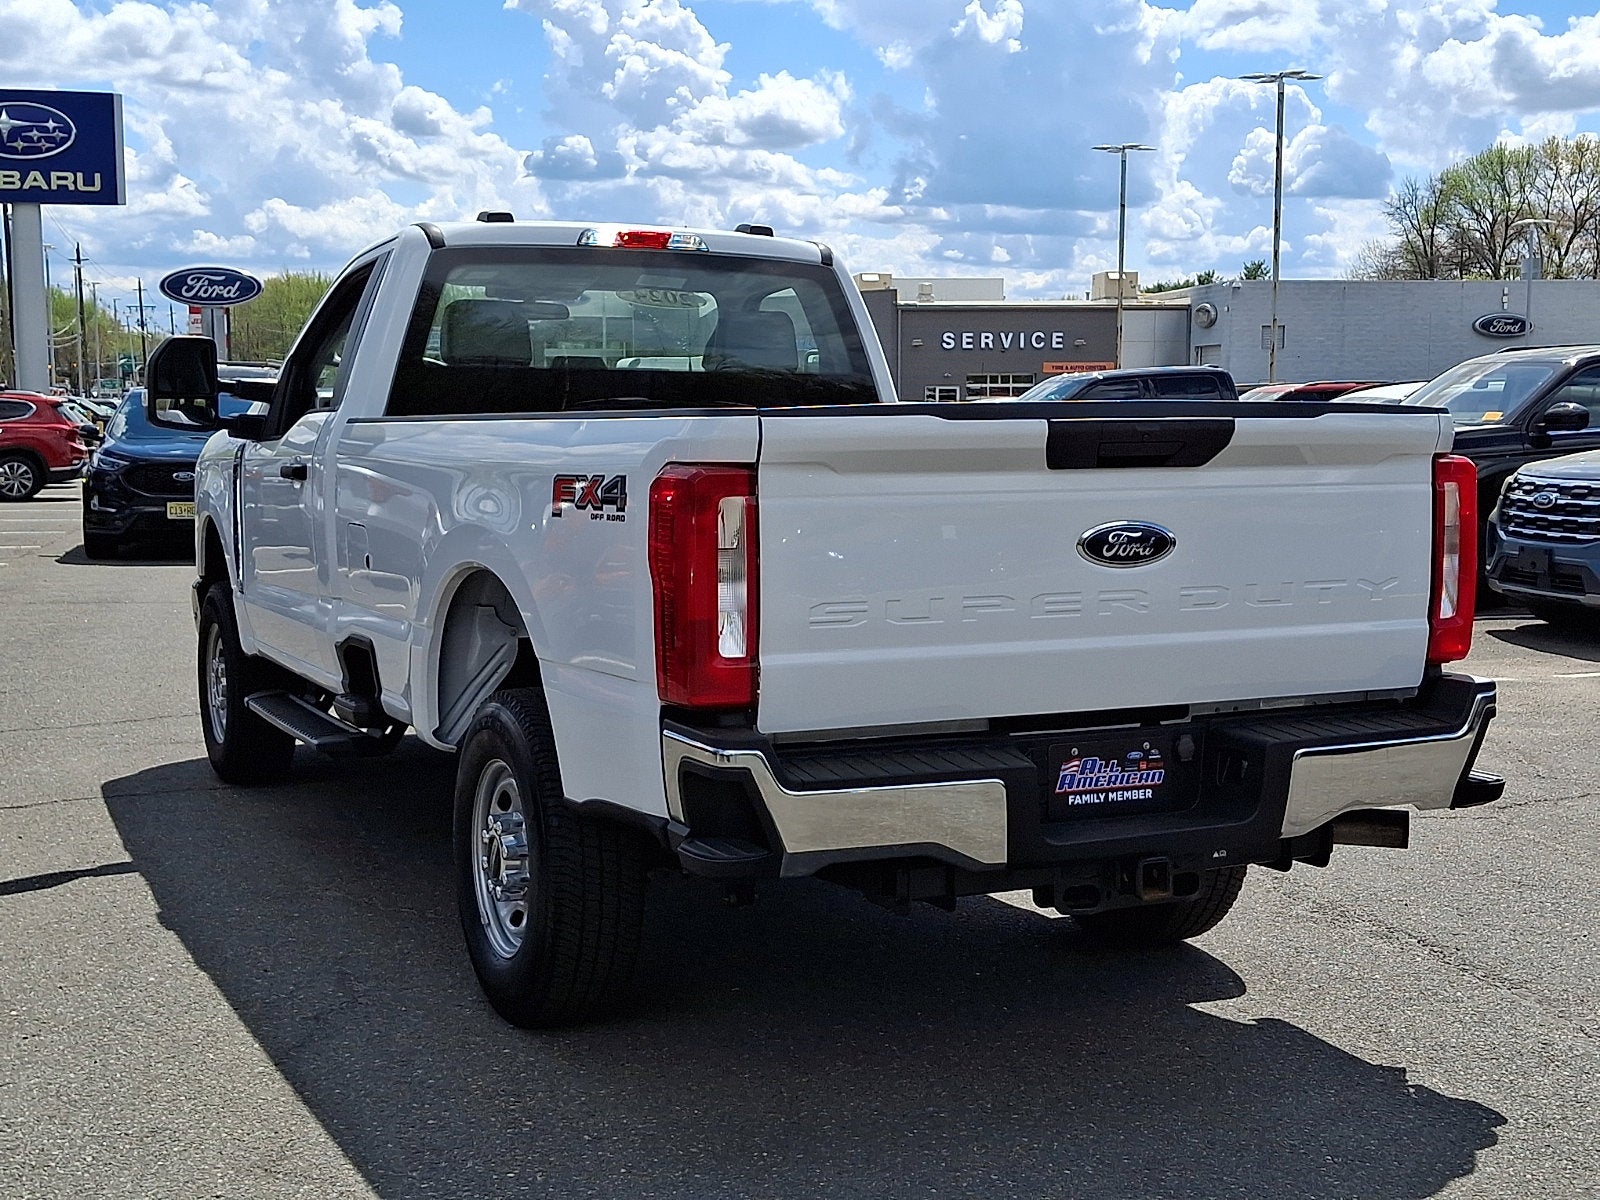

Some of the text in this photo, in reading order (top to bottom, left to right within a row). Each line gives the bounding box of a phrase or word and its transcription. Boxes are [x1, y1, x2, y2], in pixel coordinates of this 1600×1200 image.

[181, 273, 242, 298] Ford
[1490, 318, 1522, 333] Ford
[941, 331, 1065, 350] SERVICE
[552, 473, 628, 518] FX4
[590, 512, 626, 522] OFF ROAD
[1102, 531, 1156, 557] Ford
[808, 576, 1399, 629] SUPER DUTY
[1079, 757, 1122, 776] ALL
[1056, 769, 1165, 792] AMERICAN
[1068, 788, 1153, 806] FAMILY MEMBER
